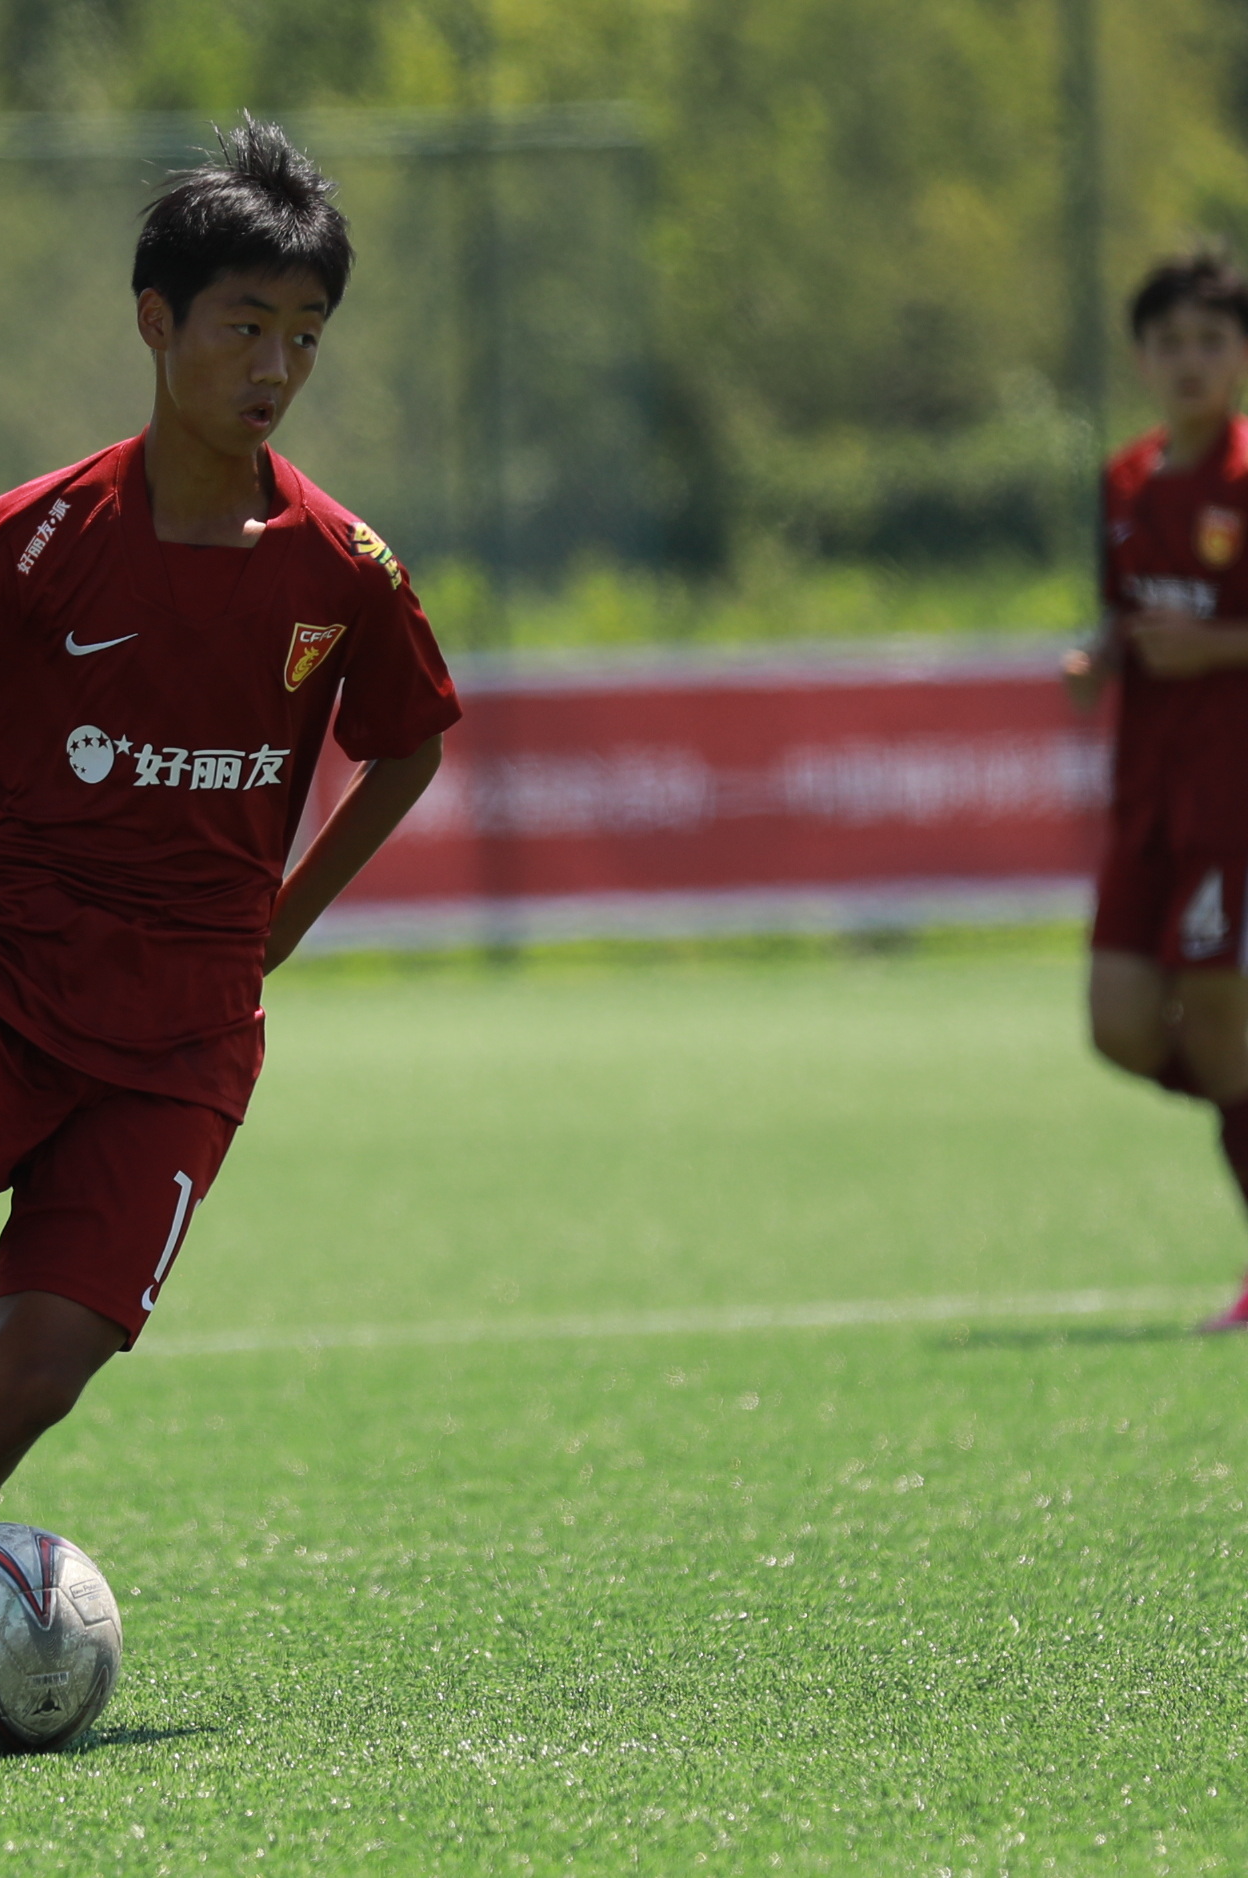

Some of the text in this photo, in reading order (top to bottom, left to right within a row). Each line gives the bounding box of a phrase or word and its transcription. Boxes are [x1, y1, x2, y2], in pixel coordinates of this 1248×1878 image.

[133, 743, 290, 790] 好丽友
[154, 1170, 202, 1283] 1
